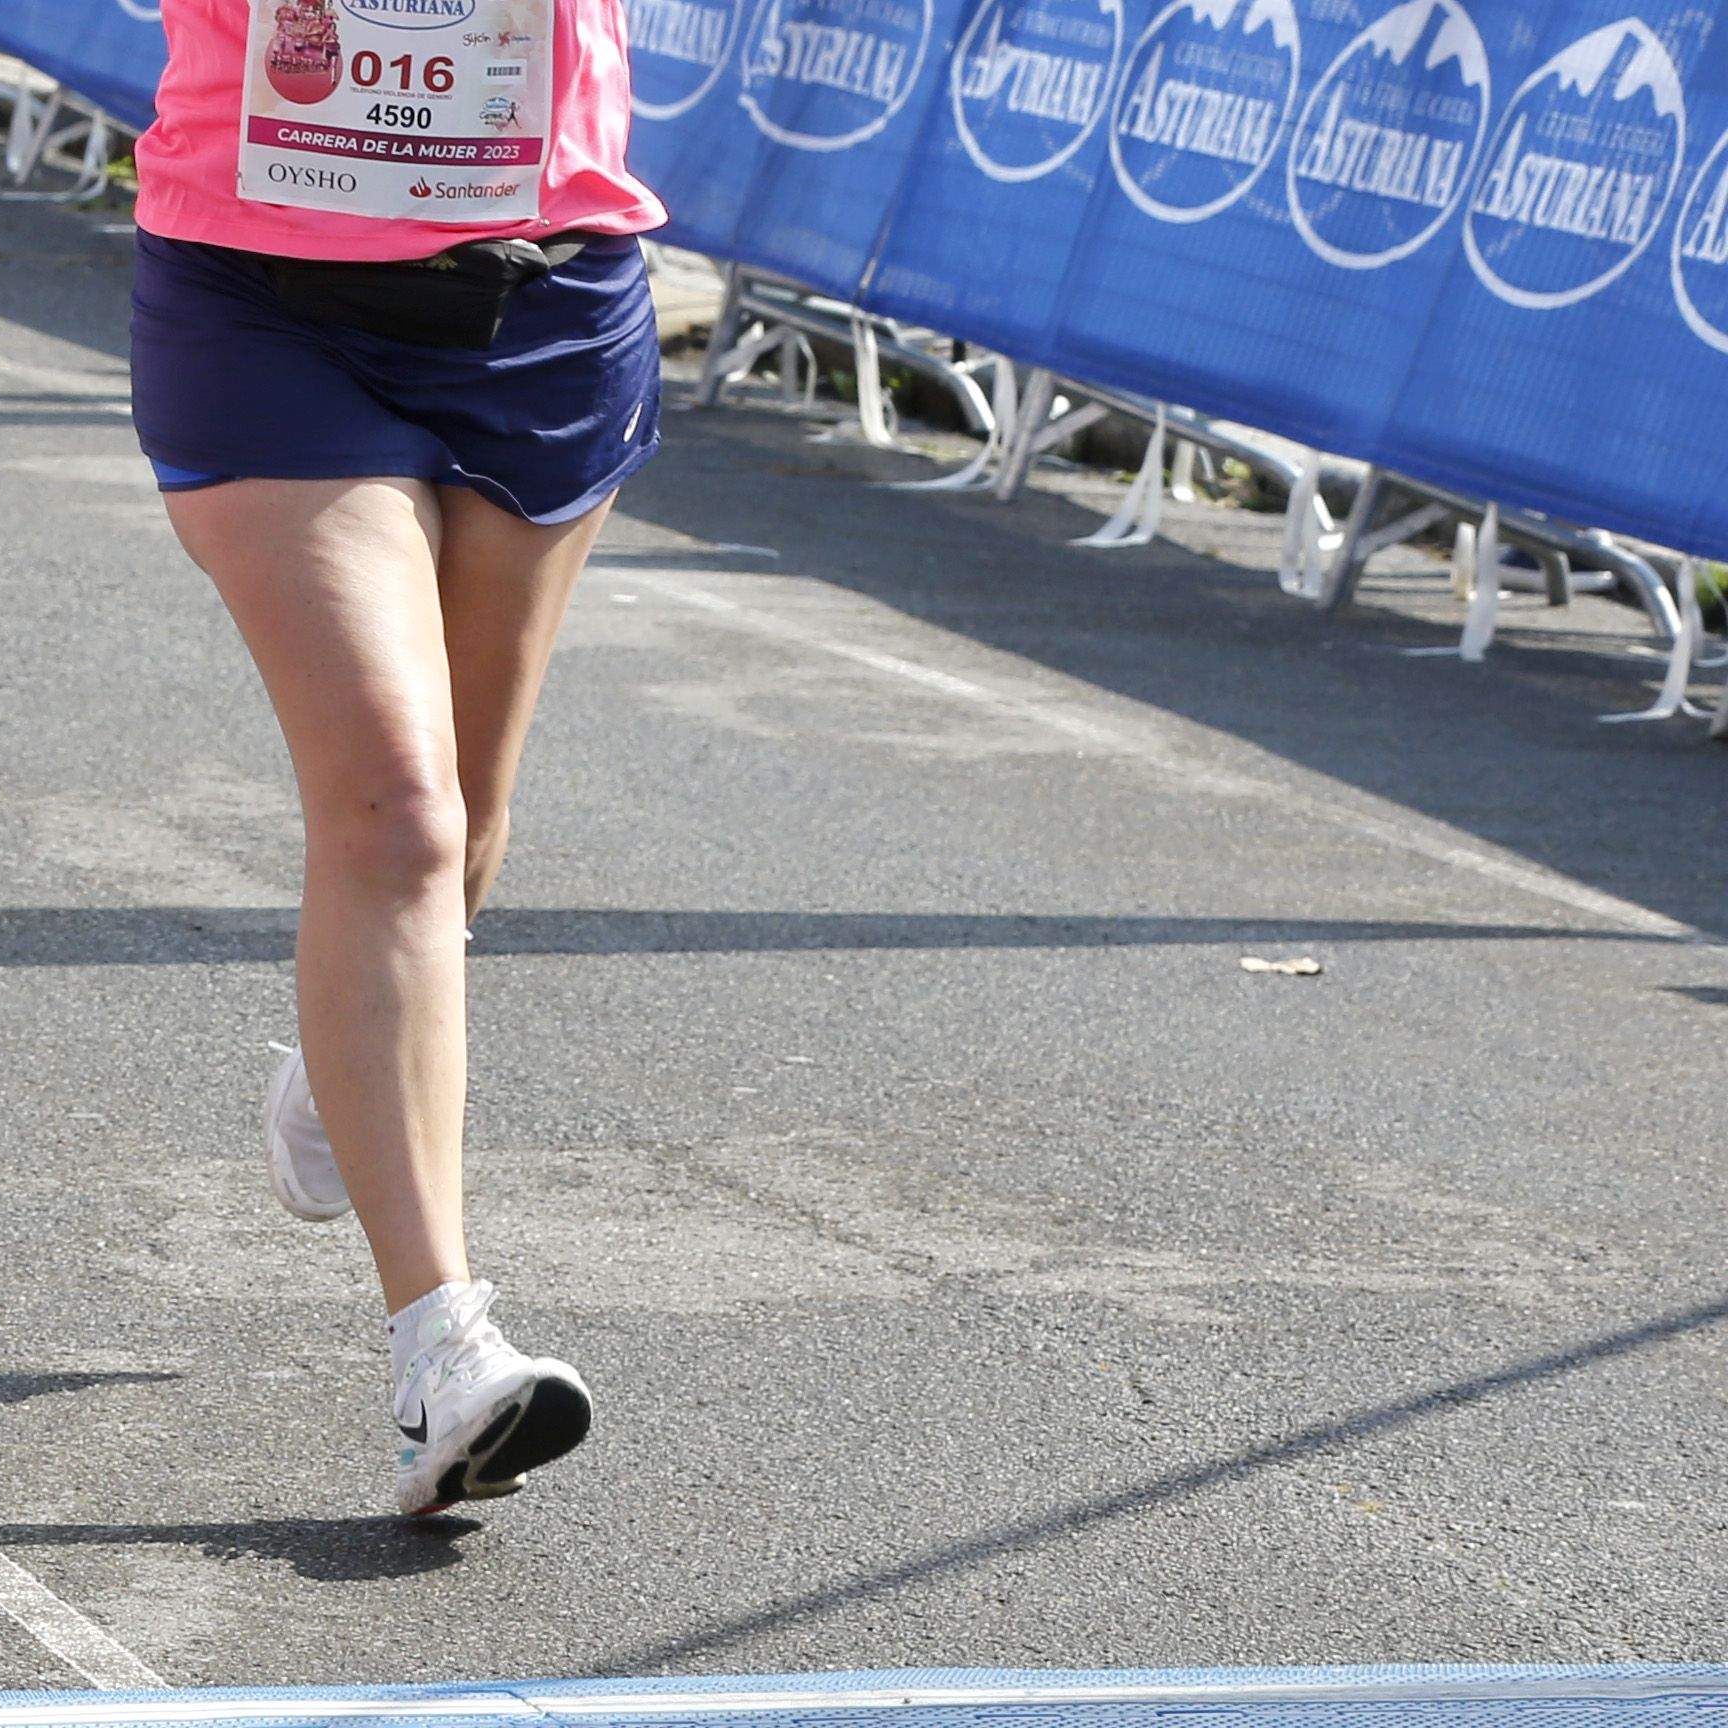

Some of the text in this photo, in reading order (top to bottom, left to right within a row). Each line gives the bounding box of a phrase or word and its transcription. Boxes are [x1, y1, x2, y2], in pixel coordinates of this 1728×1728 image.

[350, 50, 455, 93] 016
[366, 103, 432, 130] 4590
[276, 126, 521, 160] CARRERA DE LA MUJER 2023
[267, 162, 357, 194] OYSHO
[434, 180, 521, 201] Santander
[1474, 112, 1654, 246] ASTURIANA
